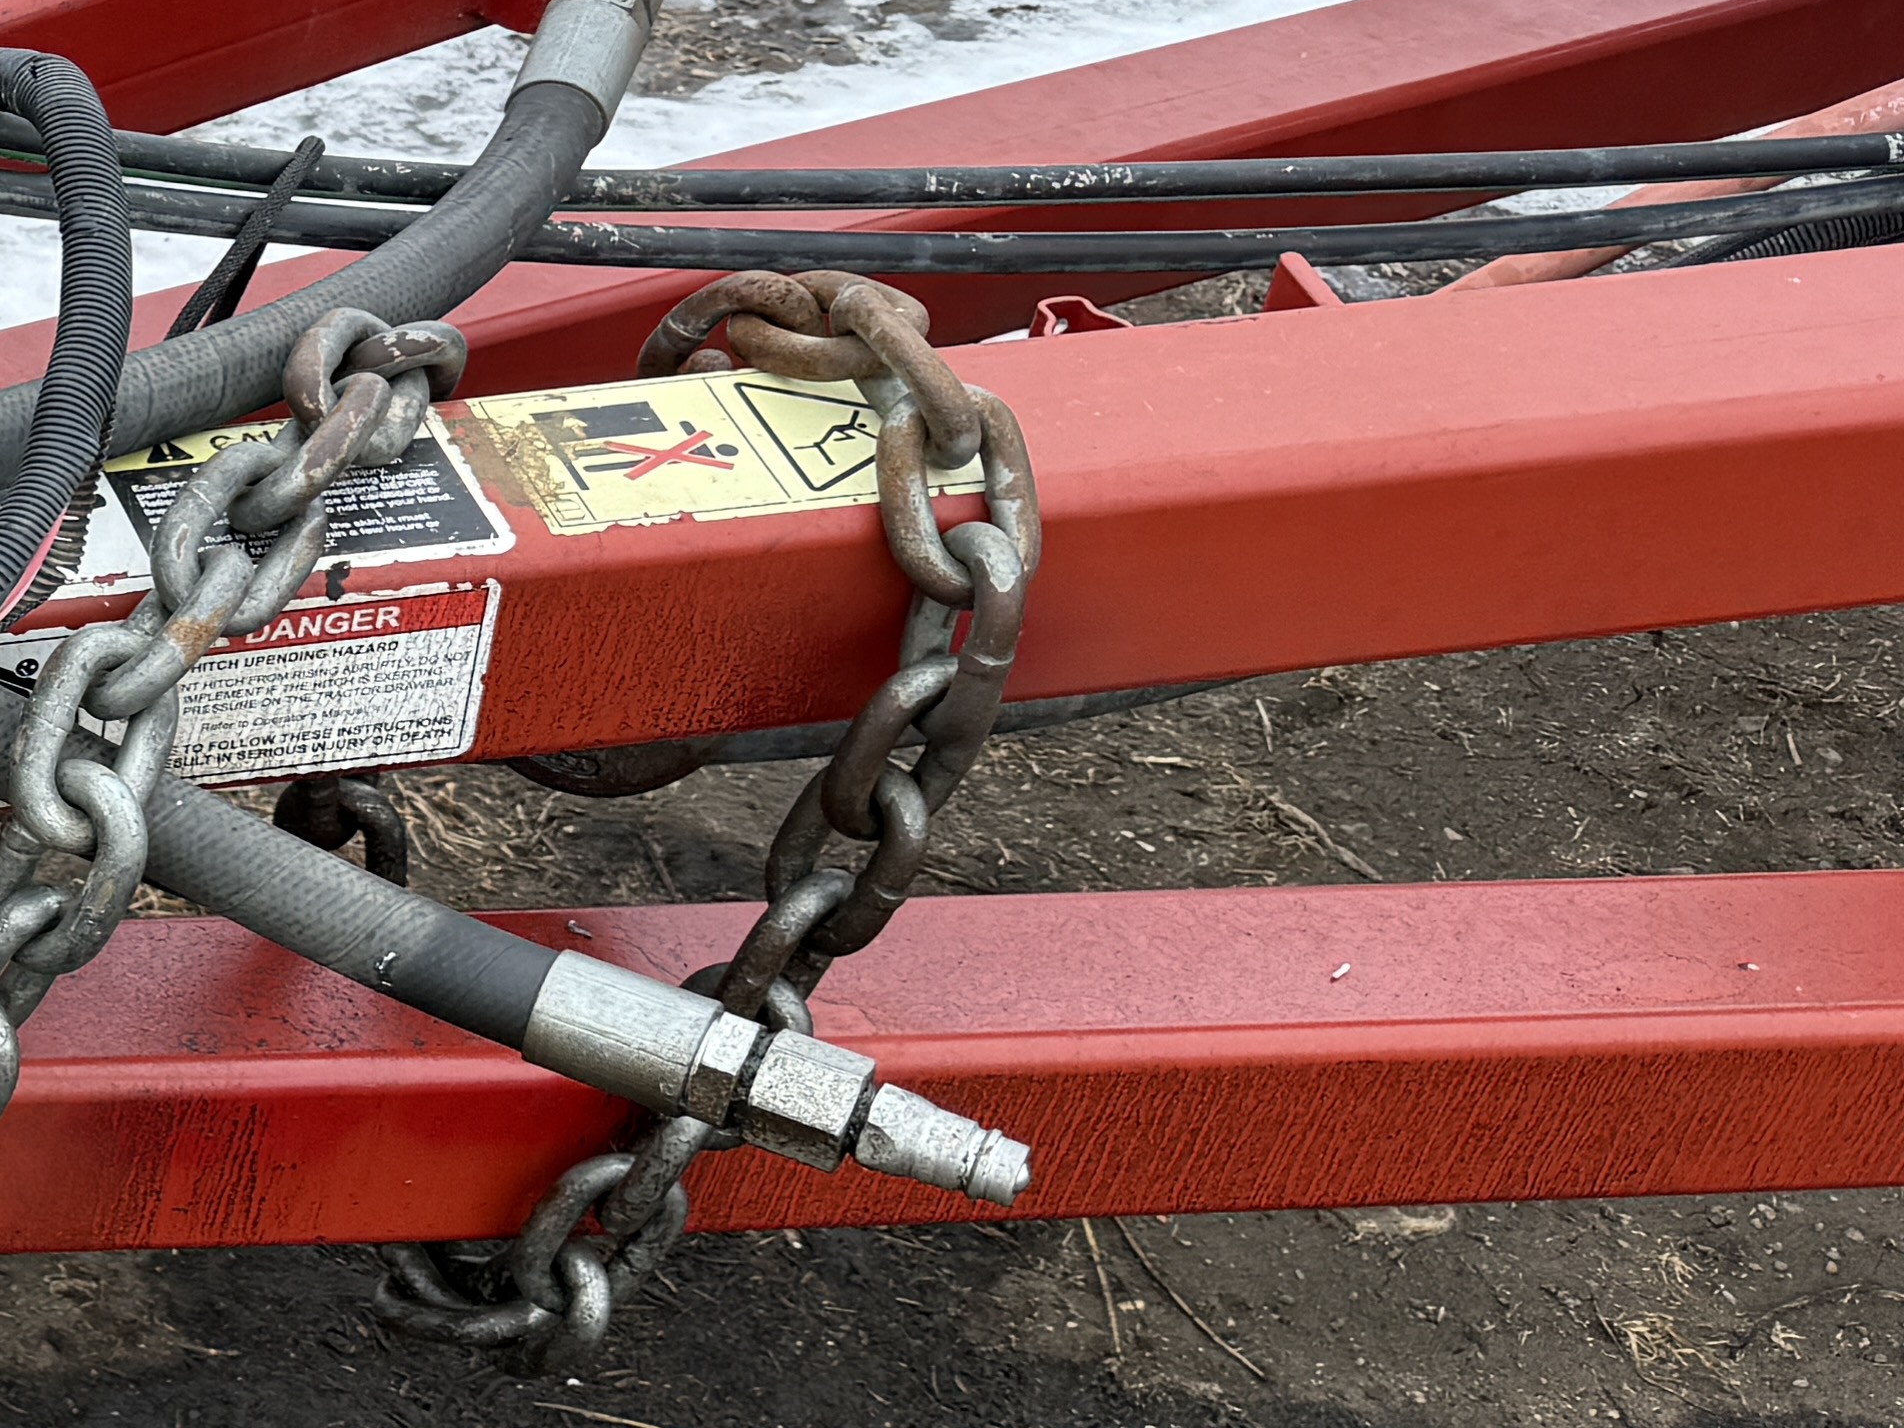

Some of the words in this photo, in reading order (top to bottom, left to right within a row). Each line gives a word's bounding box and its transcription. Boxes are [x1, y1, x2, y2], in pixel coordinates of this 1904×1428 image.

[245, 606, 401, 644] DANGER
[191, 659, 239, 673] HITCH
[244, 649, 329, 667] UPENDING
[333, 641, 399, 657] HAZARD
[183, 743, 203, 754] TO
[208, 735, 276, 751] FOLLOW
[281, 727, 332, 743] THESE
[337, 715, 453, 737] INSTRUCTIONS
[236, 744, 306, 760] SERIOUS
[311, 735, 369, 753] INJURY
[373, 735, 394, 746] OR
[400, 728, 452, 743] DEATH
